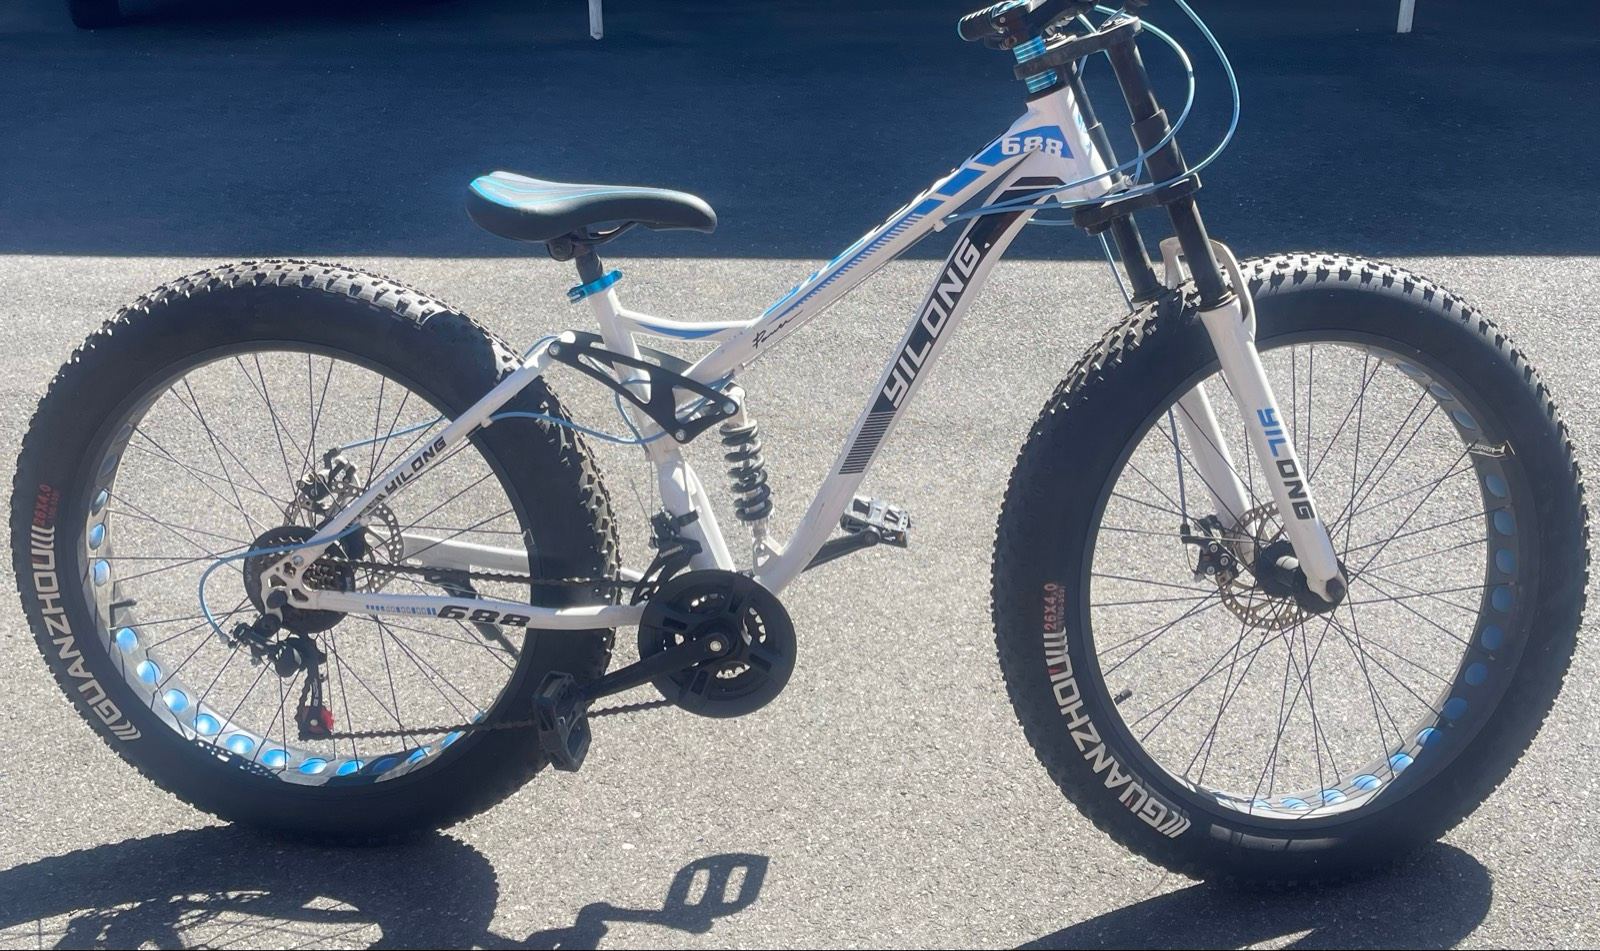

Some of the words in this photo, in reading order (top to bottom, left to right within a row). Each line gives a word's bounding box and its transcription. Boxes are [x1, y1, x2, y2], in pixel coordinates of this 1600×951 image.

[1002, 136, 1064, 157] 688
[882, 238, 981, 408] YILONG
[384, 435, 447, 493] YILONG
[1256, 407, 1315, 520] YILONG
[31, 550, 123, 721] GUANZHOU
[437, 605, 531, 627] 688
[1046, 653, 1168, 829] GUANZHOU
